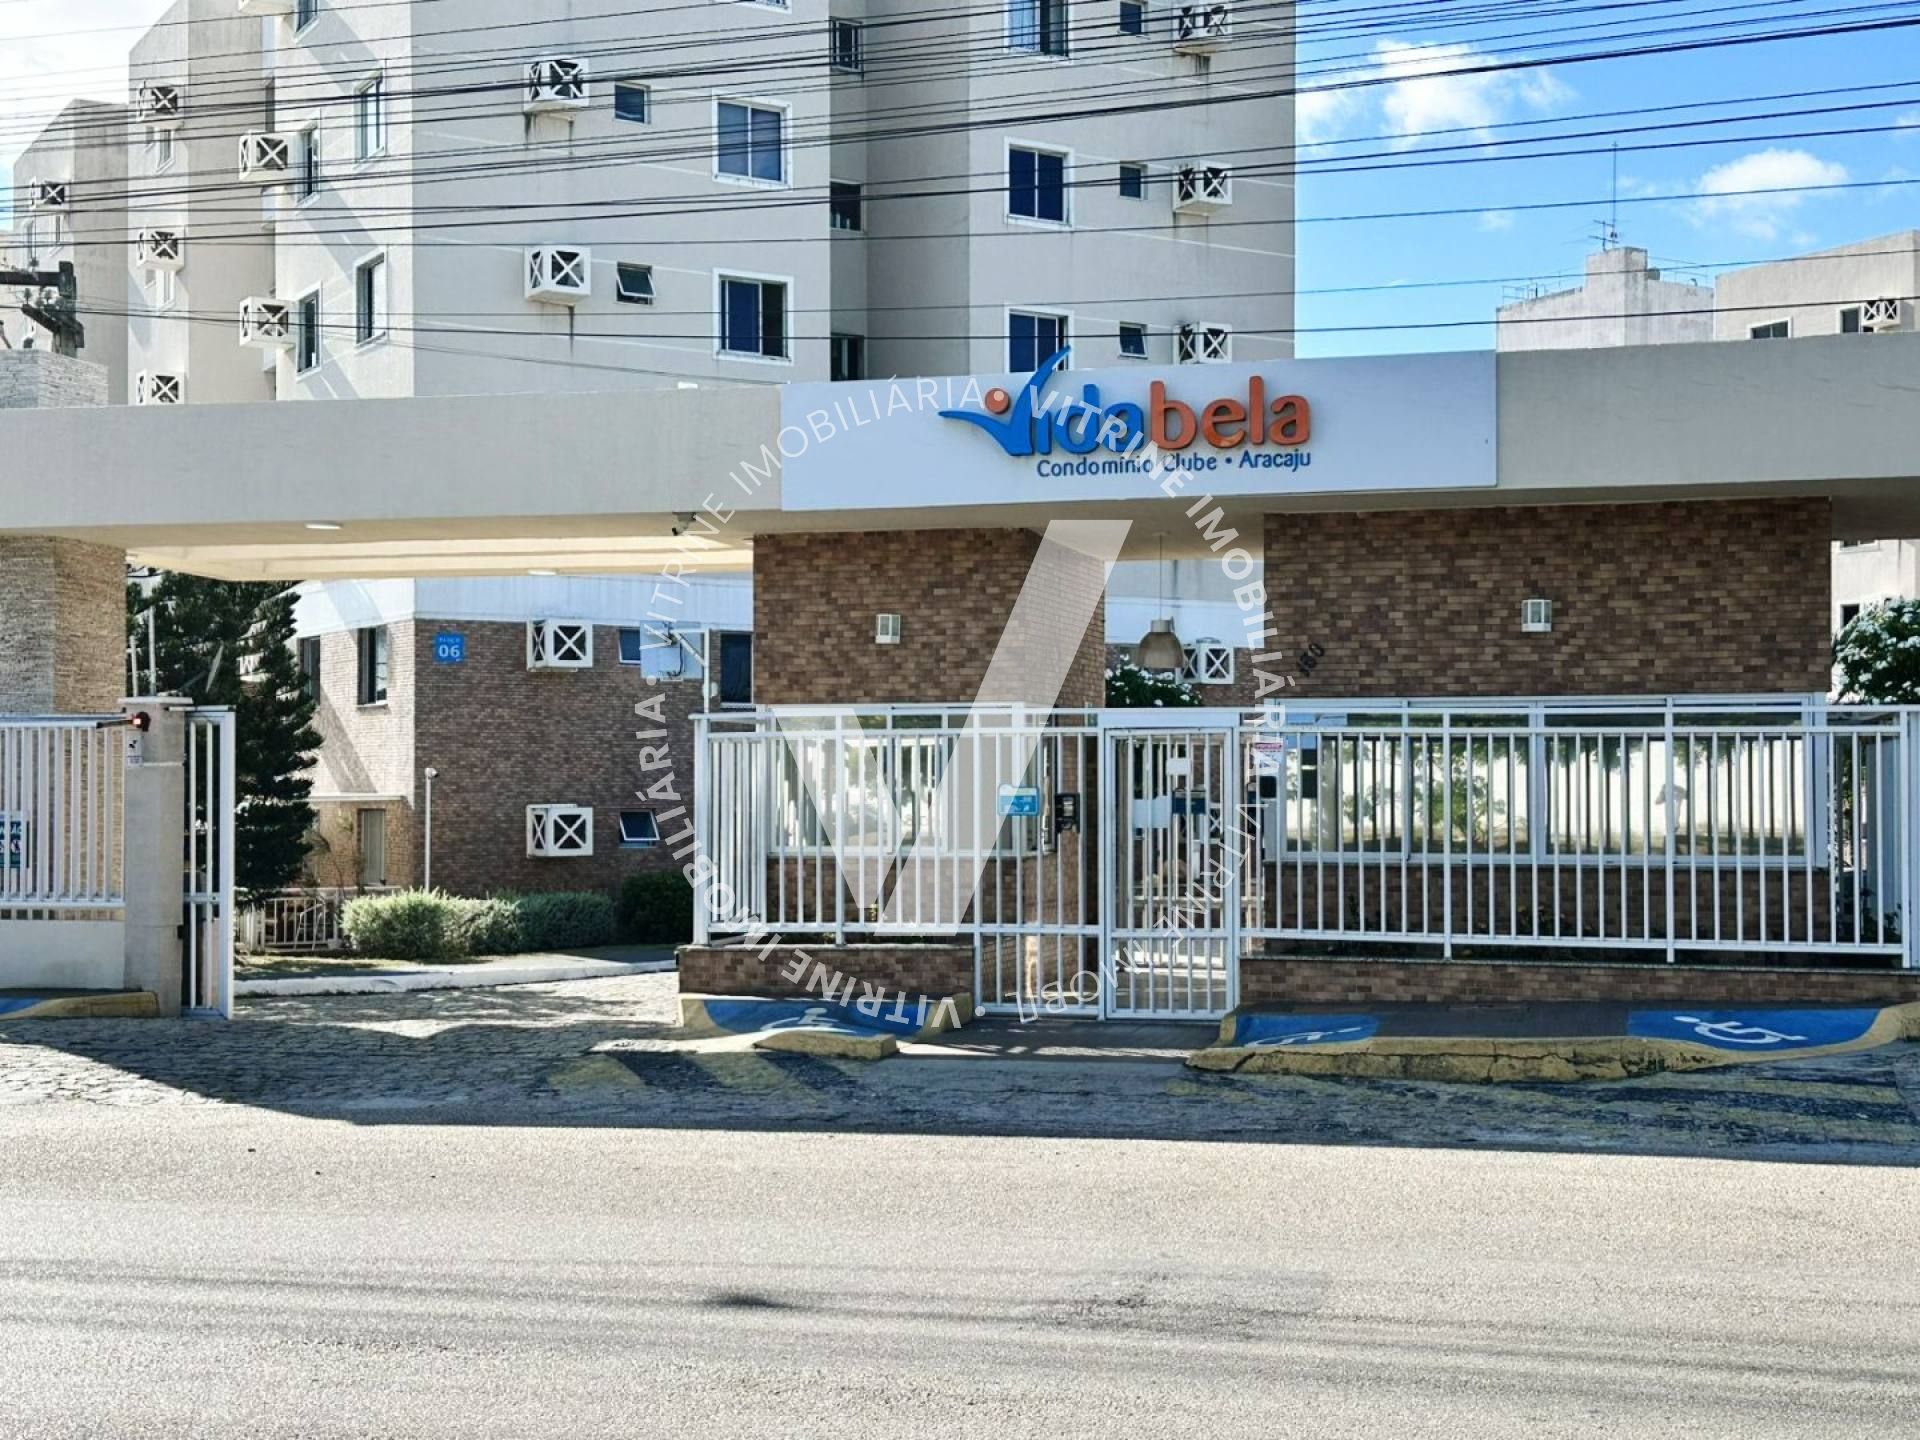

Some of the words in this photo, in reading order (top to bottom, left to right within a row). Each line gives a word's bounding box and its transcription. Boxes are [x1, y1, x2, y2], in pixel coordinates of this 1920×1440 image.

[1163, 451, 1217, 472] Clube
[1238, 449, 1312, 472] Aracaju
[439, 644, 461, 657] 06
